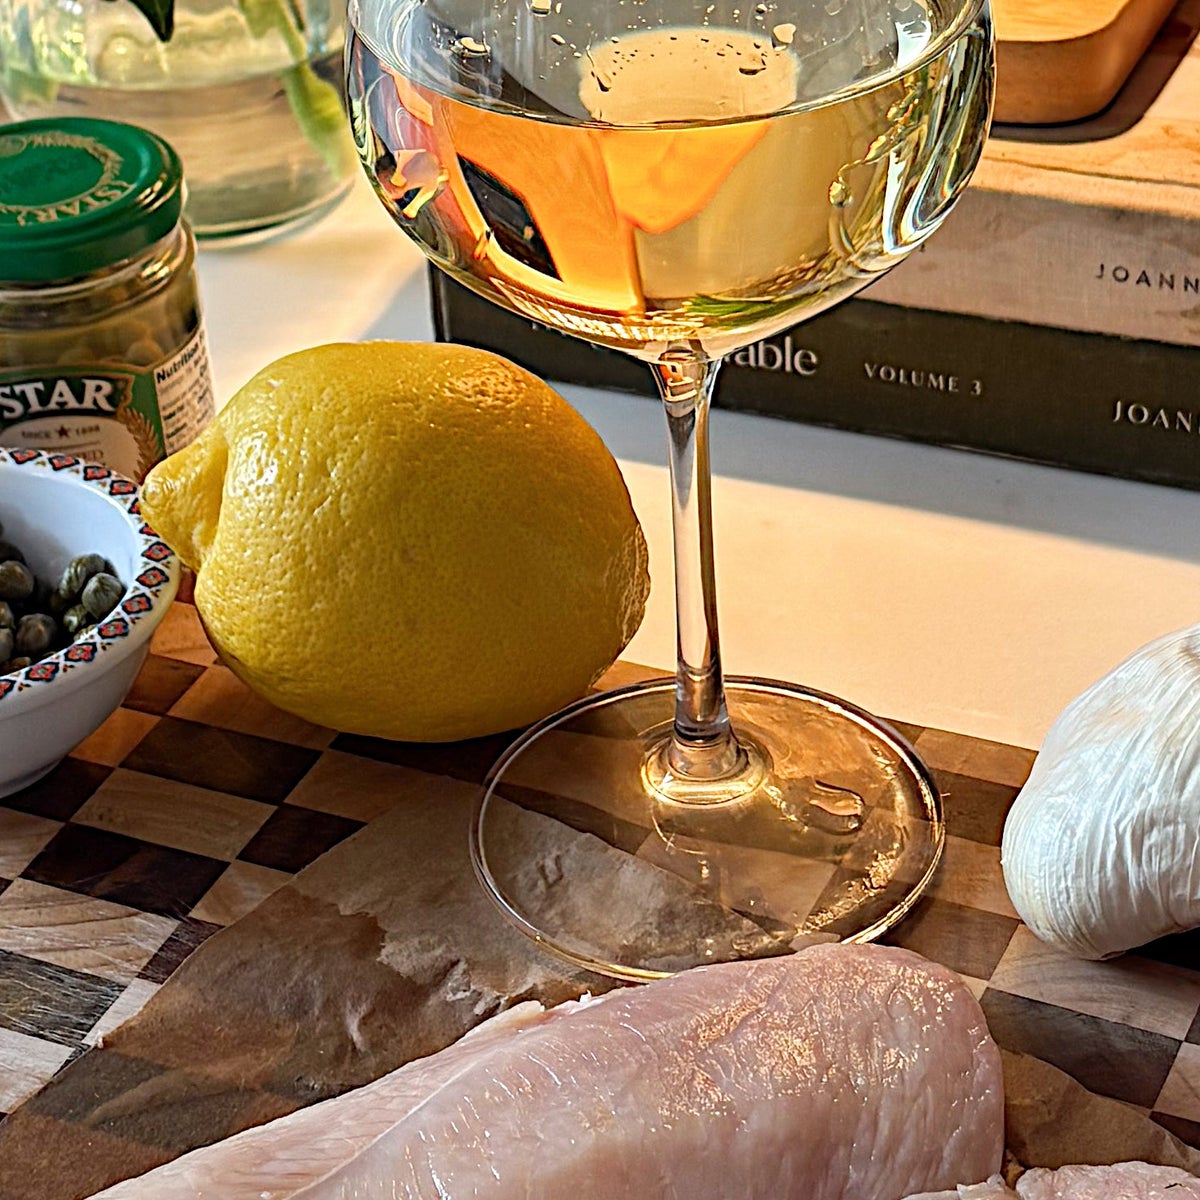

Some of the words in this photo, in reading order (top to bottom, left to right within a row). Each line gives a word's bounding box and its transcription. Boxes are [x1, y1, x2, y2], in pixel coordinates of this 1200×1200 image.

[156, 342, 199, 385] Nutrition
[723, 334, 818, 376] able
[863, 361, 960, 393] VOLUME
[970, 379, 983, 397] 3
[0, 378, 116, 420] STAR
